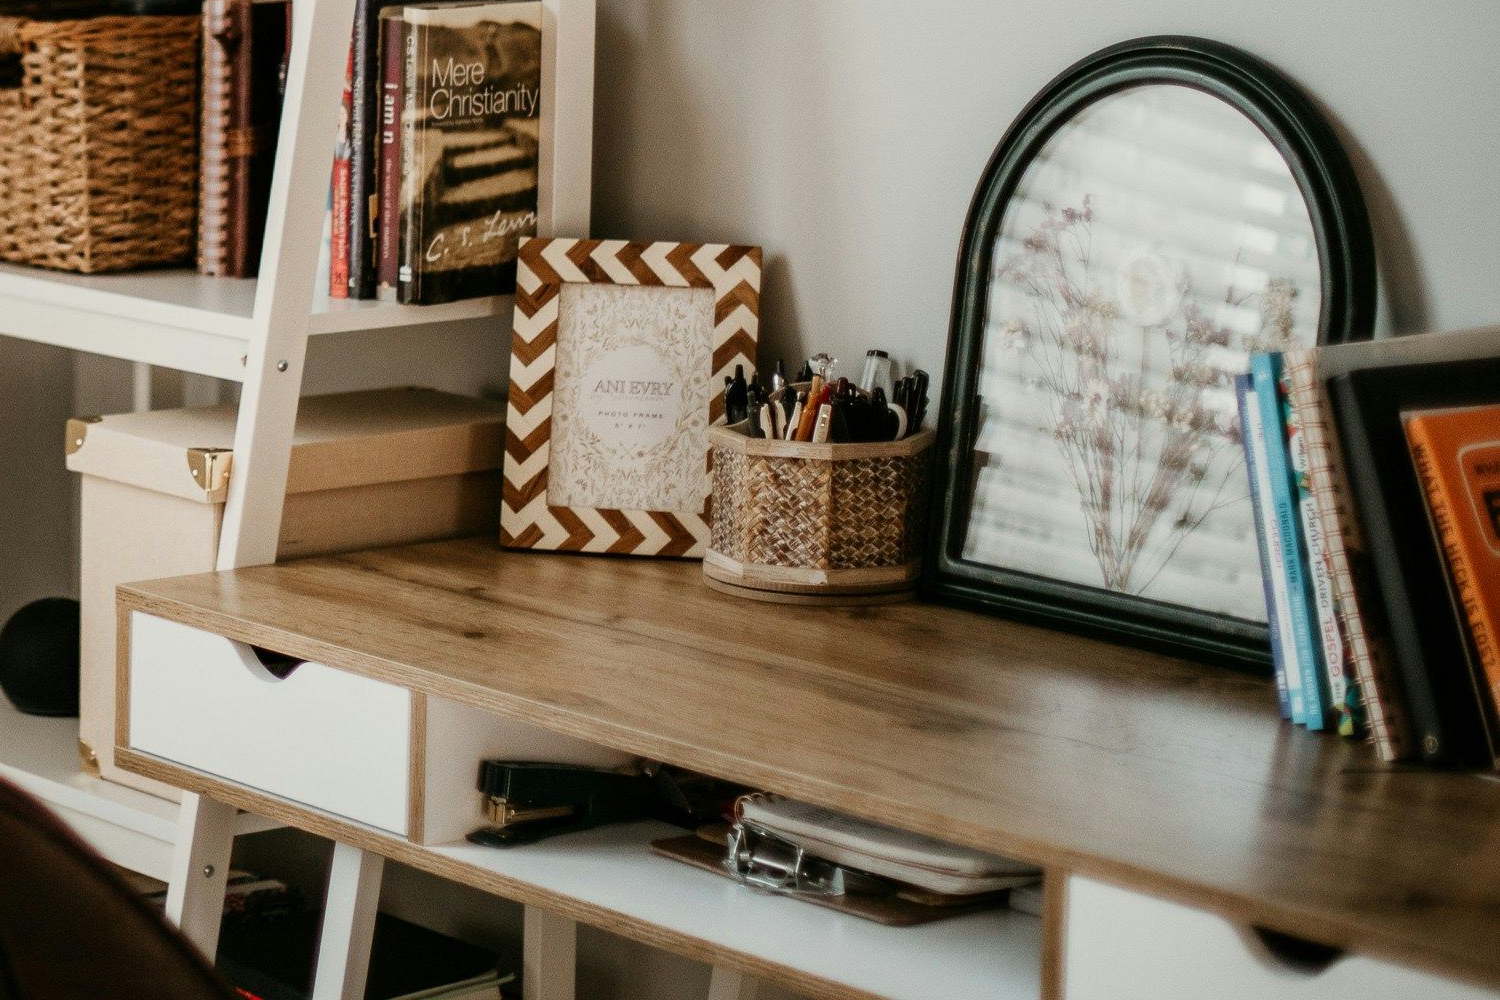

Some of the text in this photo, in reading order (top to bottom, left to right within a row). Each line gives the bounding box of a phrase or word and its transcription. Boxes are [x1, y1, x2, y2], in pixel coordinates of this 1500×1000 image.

[385, 82, 398, 90] i
[432, 57, 485, 88] Mere
[384, 94, 395, 125] am
[430, 82, 539, 120] Christianity
[628, 381, 674, 396] EVRY
[598, 410, 663, 420] PHOTO FRAME
[1304, 501, 1322, 556] CHURCH
[1431, 501, 1453, 537] THE
[1444, 542, 1470, 592] HECK
[1286, 558, 1298, 583] MARK
[1334, 682, 1342, 698] THE
